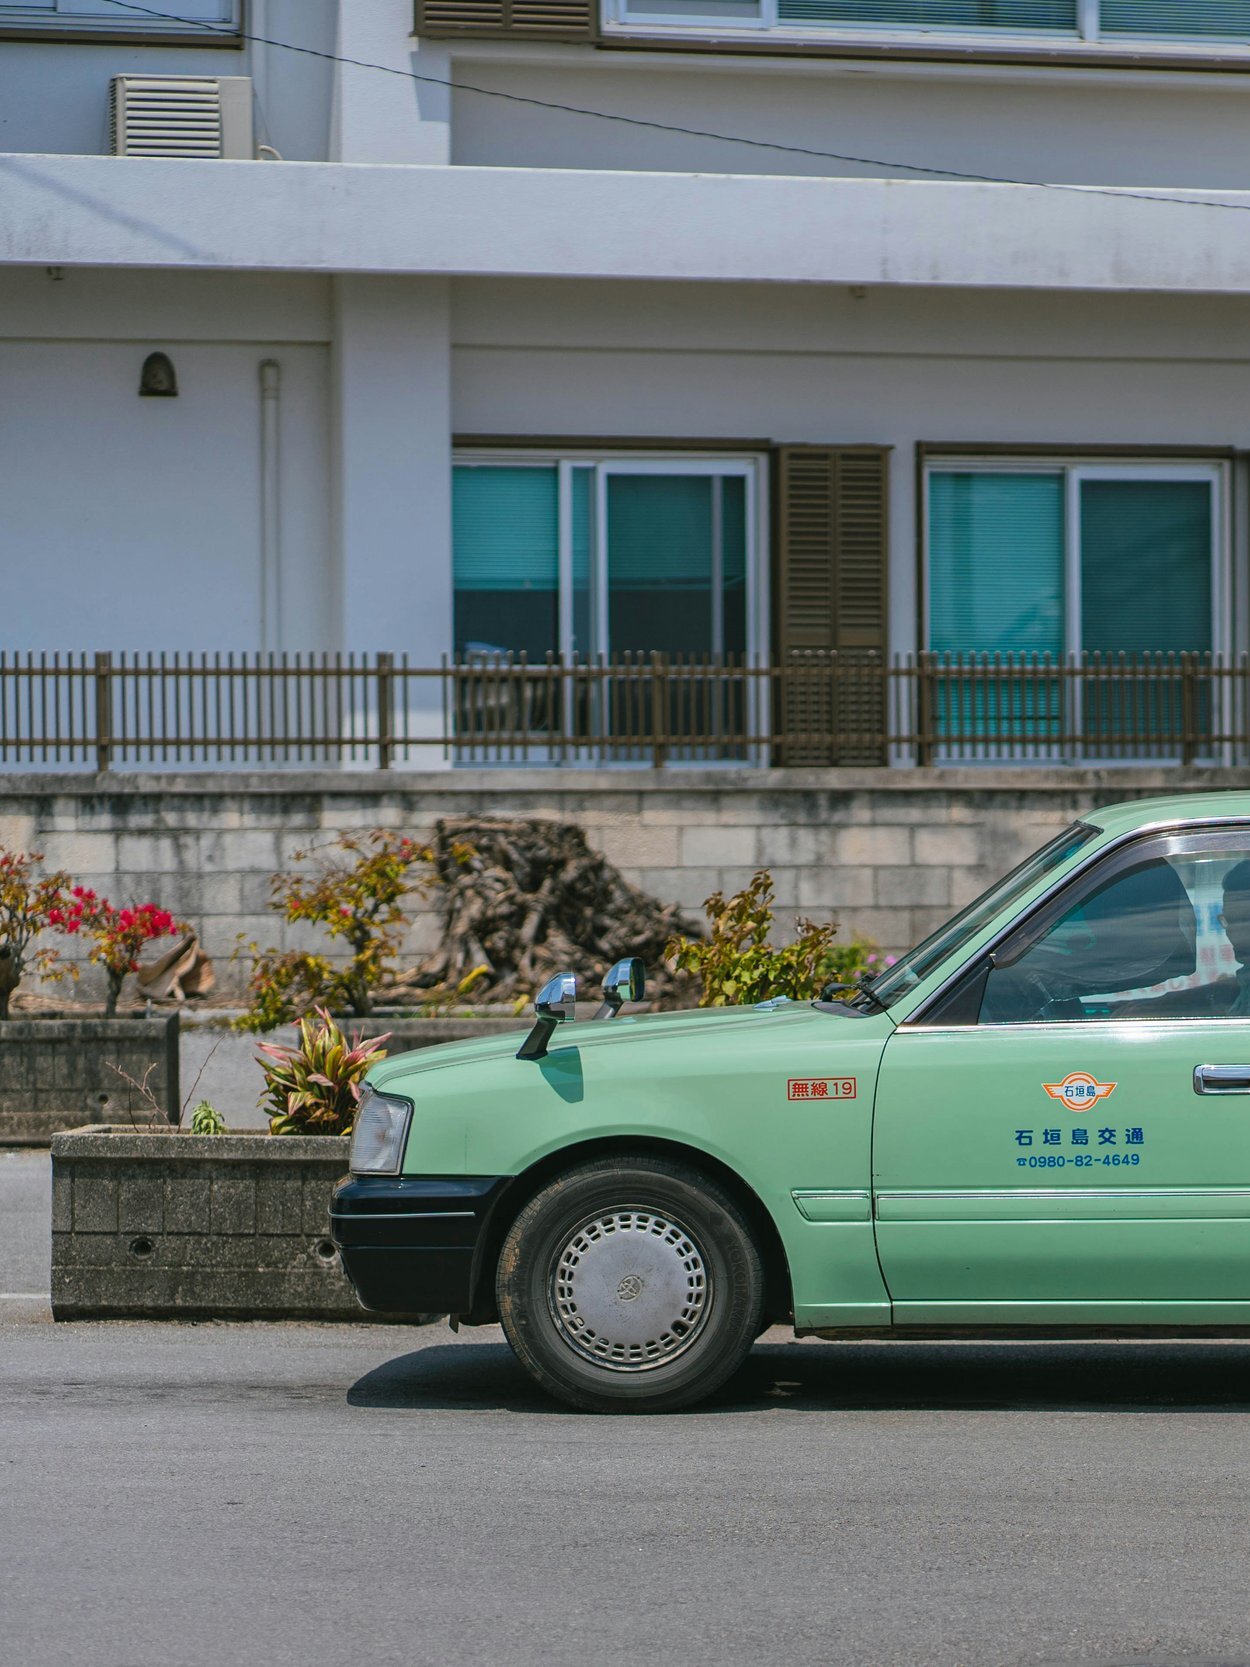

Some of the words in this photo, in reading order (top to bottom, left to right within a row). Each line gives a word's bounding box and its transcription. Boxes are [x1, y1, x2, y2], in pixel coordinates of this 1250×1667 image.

[1064, 1085, 1096, 1097] 石垣島
[1015, 1128, 1145, 1146] 石垣島交通
[1028, 1153, 1140, 1168] 0980-82-4649
